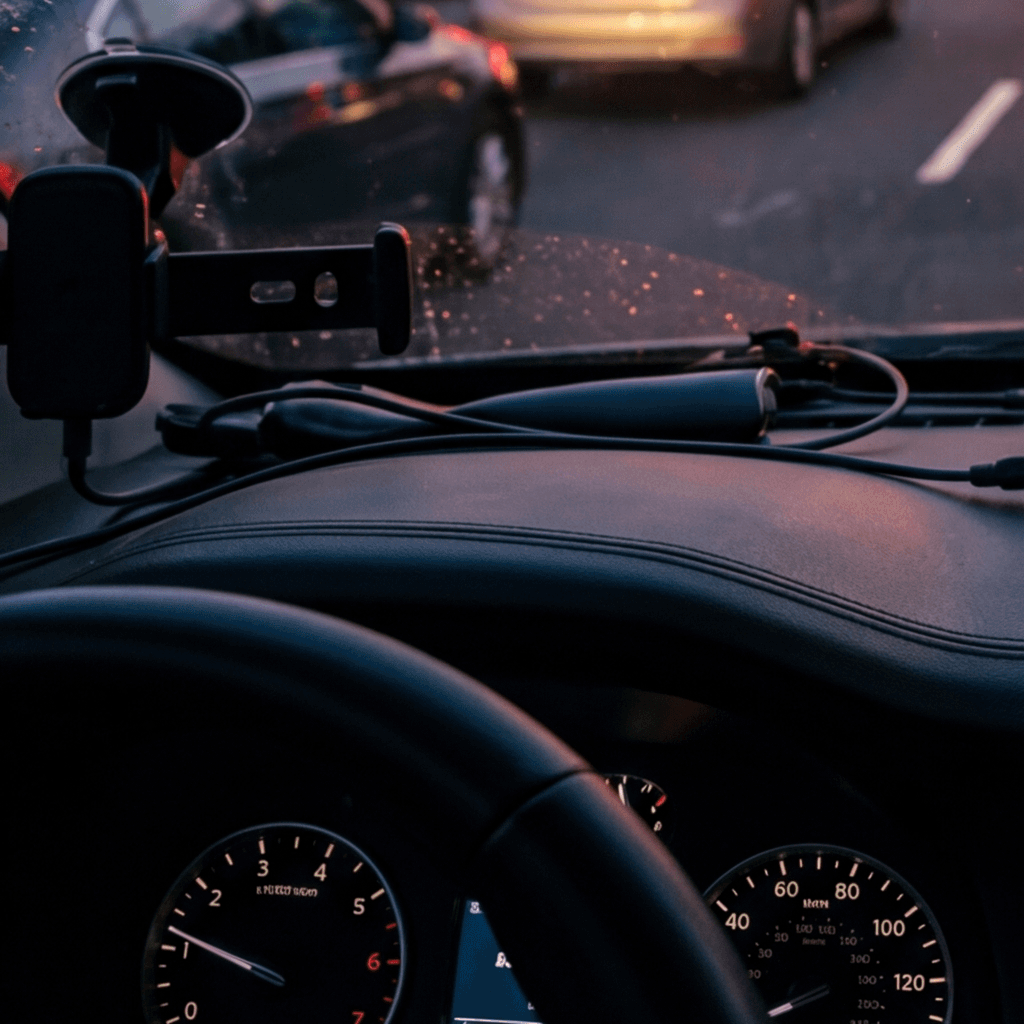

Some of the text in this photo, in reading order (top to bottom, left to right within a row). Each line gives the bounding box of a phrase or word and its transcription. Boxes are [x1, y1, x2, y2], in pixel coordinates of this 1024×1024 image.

[257, 860, 269, 877] 3
[314, 863, 327, 882] 4
[775, 881, 799, 897] 60
[835, 883, 860, 900] 80
[208, 890, 221, 907] 2
[353, 898, 365, 914] 5
[725, 913, 750, 930] 40
[873, 919, 906, 937] 100
[183, 942, 190, 959] 1
[367, 953, 380, 971] 6
[893, 974, 925, 991] 120
[185, 1002, 198, 1020] 0
[352, 1011, 364, 1024] 7
